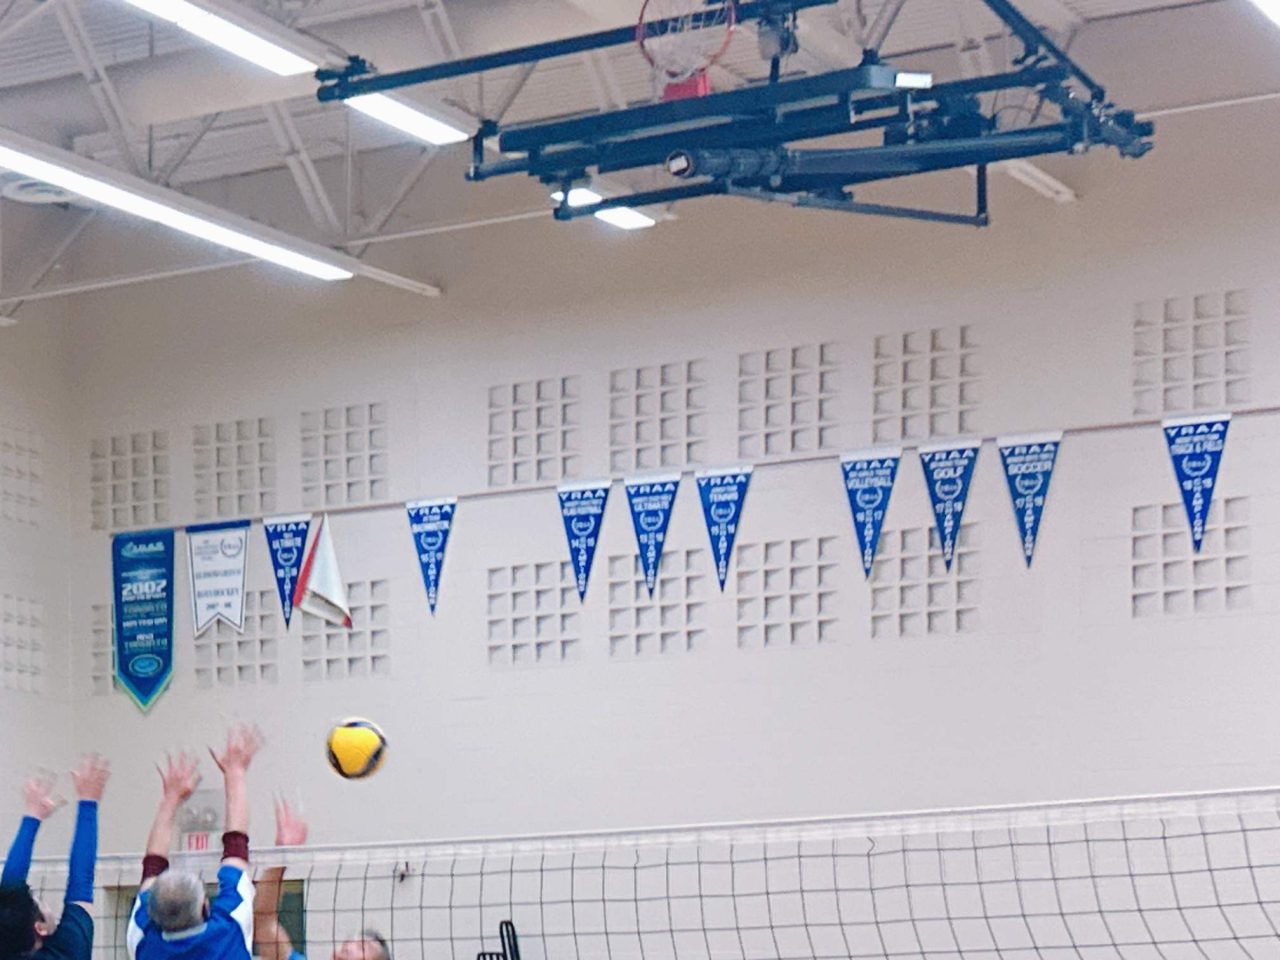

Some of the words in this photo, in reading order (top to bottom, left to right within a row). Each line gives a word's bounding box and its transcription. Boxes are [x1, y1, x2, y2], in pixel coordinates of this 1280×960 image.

[1167, 423, 1224, 437] YRAA
[922, 449, 974, 463] YRAA
[1002, 444, 1054, 456] YRAA
[843, 460, 894, 471] YRAA
[1008, 461, 1052, 475] SOCCER
[933, 466, 964, 480] GOLF
[699, 476, 746, 487] YRAA
[847, 476, 892, 489] VOLLEYBALL
[560, 489, 605, 500] YRAA
[628, 483, 675, 495] YRAA
[409, 505, 451, 517] YRAA
[267, 523, 307, 532] YRAA
[121, 579, 167, 596] 2007
